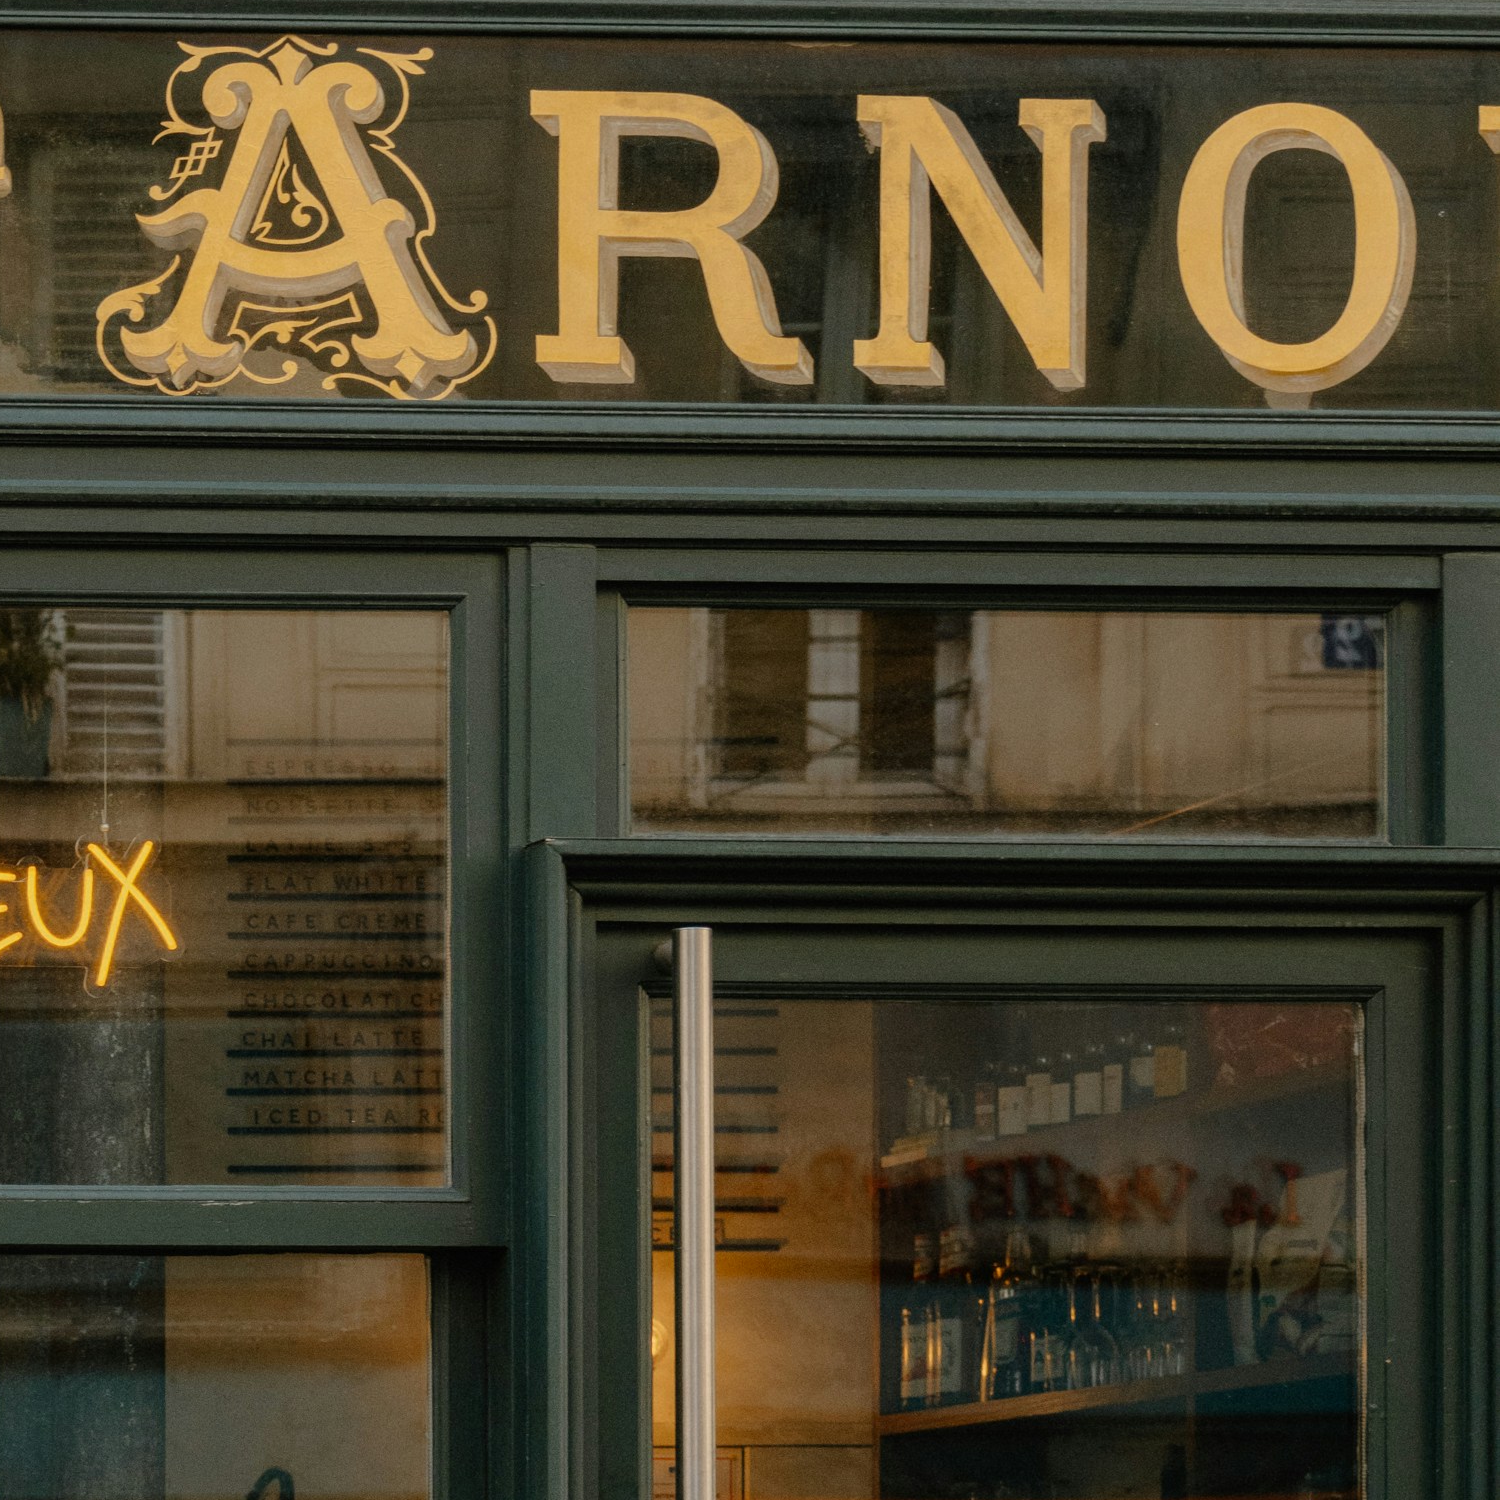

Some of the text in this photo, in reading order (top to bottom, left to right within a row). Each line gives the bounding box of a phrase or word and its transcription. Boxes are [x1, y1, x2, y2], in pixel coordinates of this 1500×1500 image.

[245, 760, 395, 776] ESPRESSO
[245, 874, 427, 891] FLAT WHITE
[244, 953, 435, 969] CAPPUCCINO
[244, 993, 394, 1008] CHOCOLAT
[242, 1030, 423, 1048] CHAI LATTE
[243, 1069, 356, 1086] MATCHA
[252, 1108, 323, 1125] ICED
[344, 1108, 398, 1124] TEA
